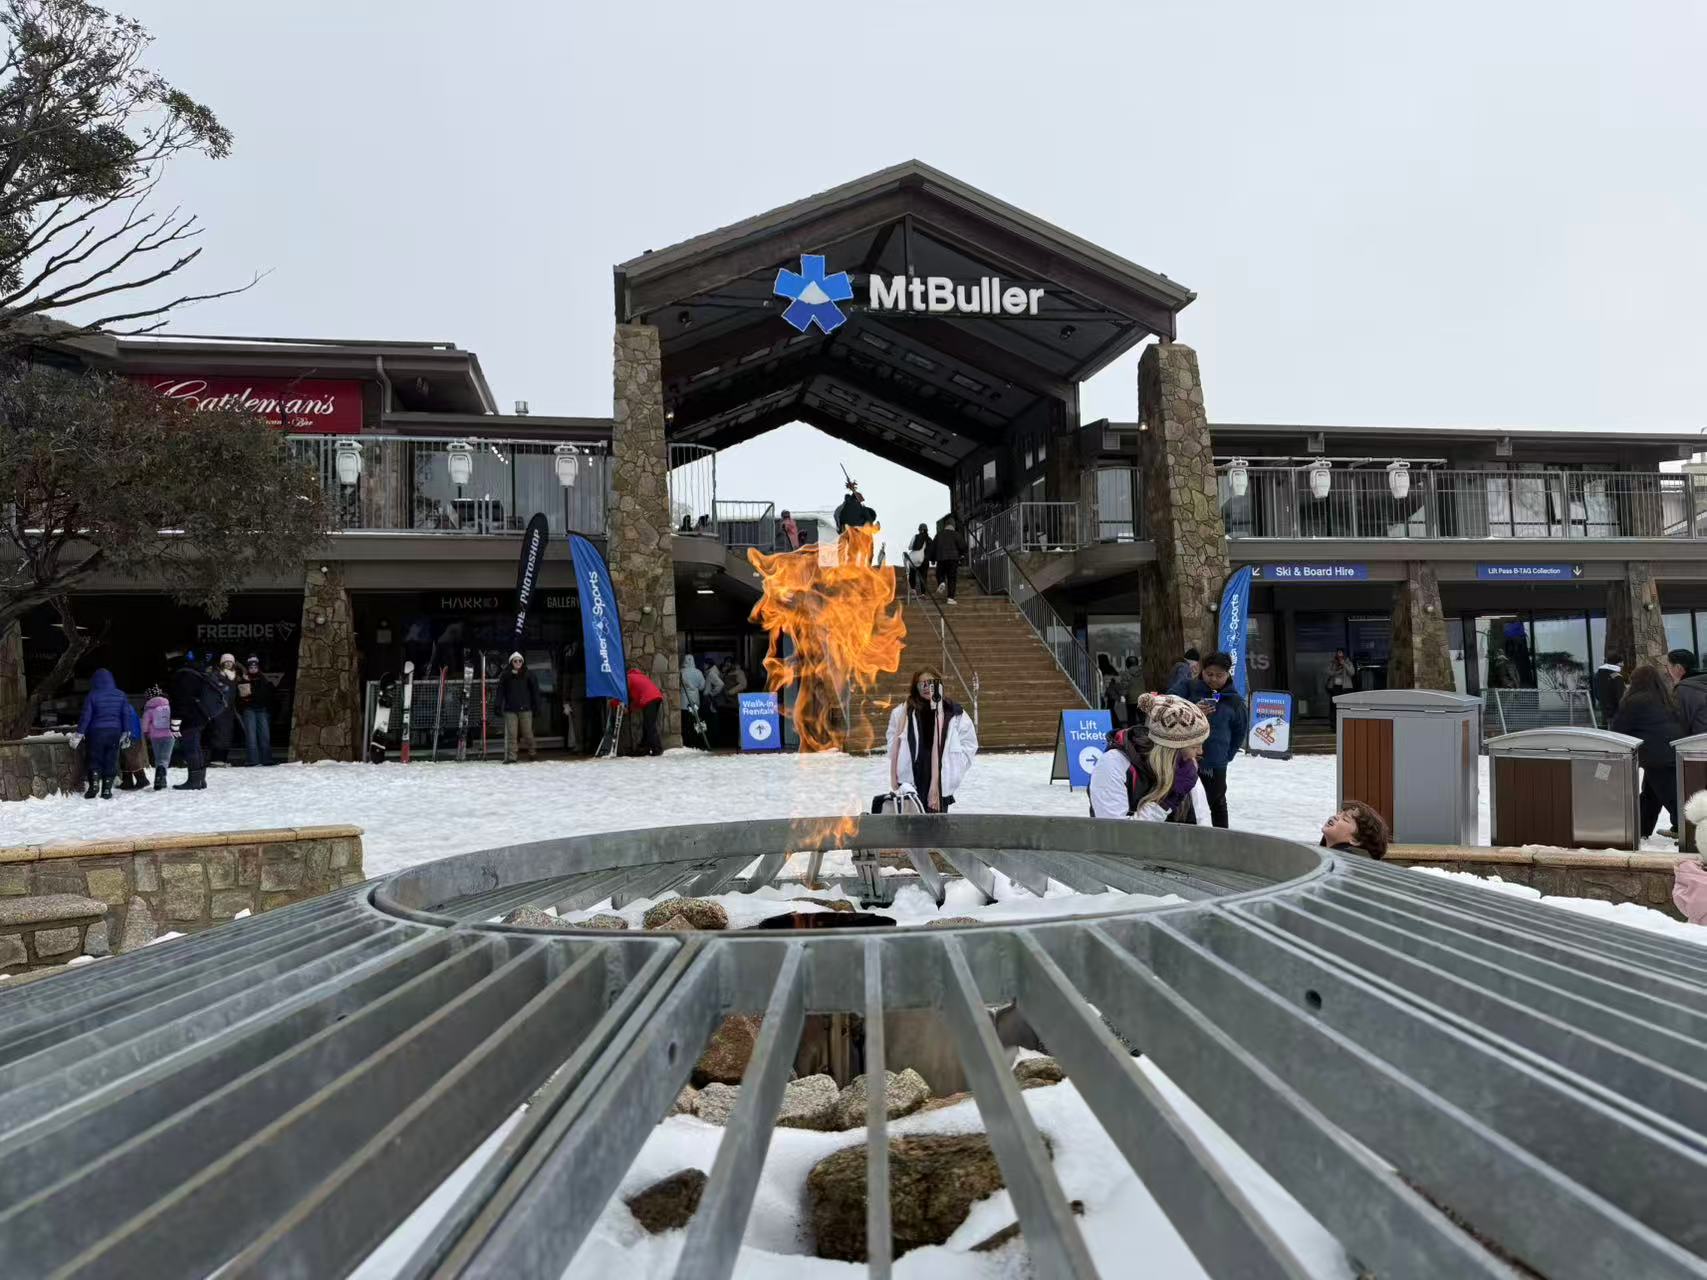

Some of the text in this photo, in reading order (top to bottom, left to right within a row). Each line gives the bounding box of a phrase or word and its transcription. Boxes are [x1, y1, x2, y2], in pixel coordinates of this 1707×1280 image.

[869, 273, 1045, 316] MtBuller
[520, 529, 540, 604] PHOTOSHOP
[1275, 567, 1355, 577] Ski & Board Hire
[1488, 567, 1498, 575] Lift
[1513, 567, 1532, 575] B-TAG
[1532, 567, 1561, 575] Collection
[588, 570, 612, 673] Buller Sports
[1229, 593, 1240, 630] Sports
[196, 623, 275, 639] FREERIDE
[1079, 720, 1097, 730] Lift
